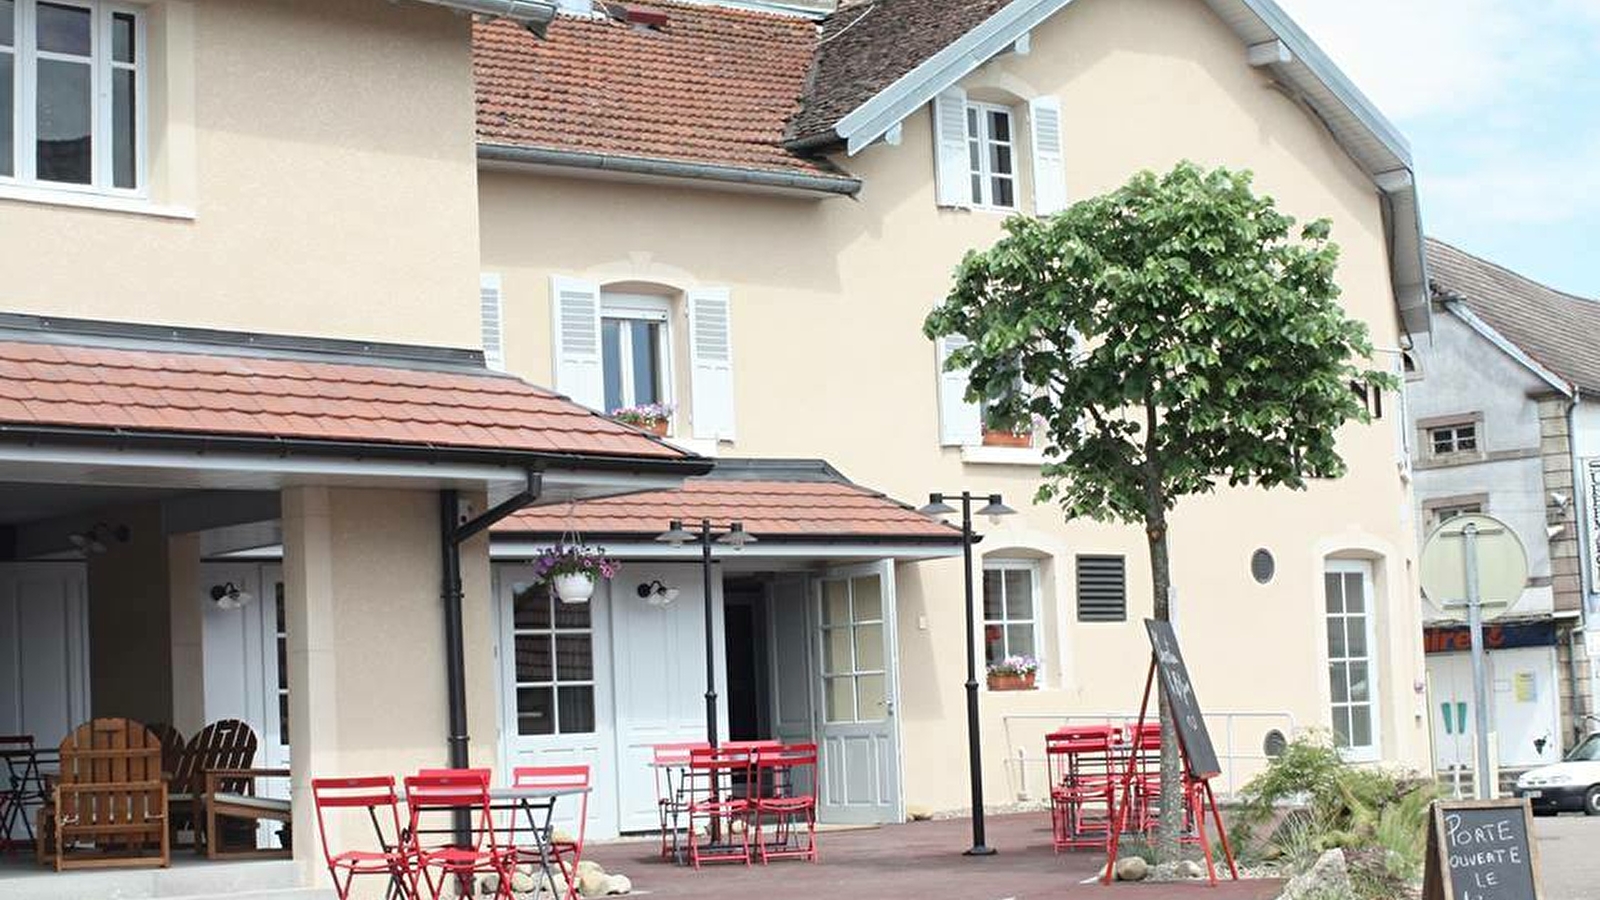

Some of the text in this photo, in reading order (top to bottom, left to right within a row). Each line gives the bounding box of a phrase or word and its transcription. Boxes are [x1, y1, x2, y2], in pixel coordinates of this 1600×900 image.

[1446, 814, 1514, 846] PORTE
[1450, 846, 1521, 868] OUVERTE
[1475, 872, 1499, 888] LE
